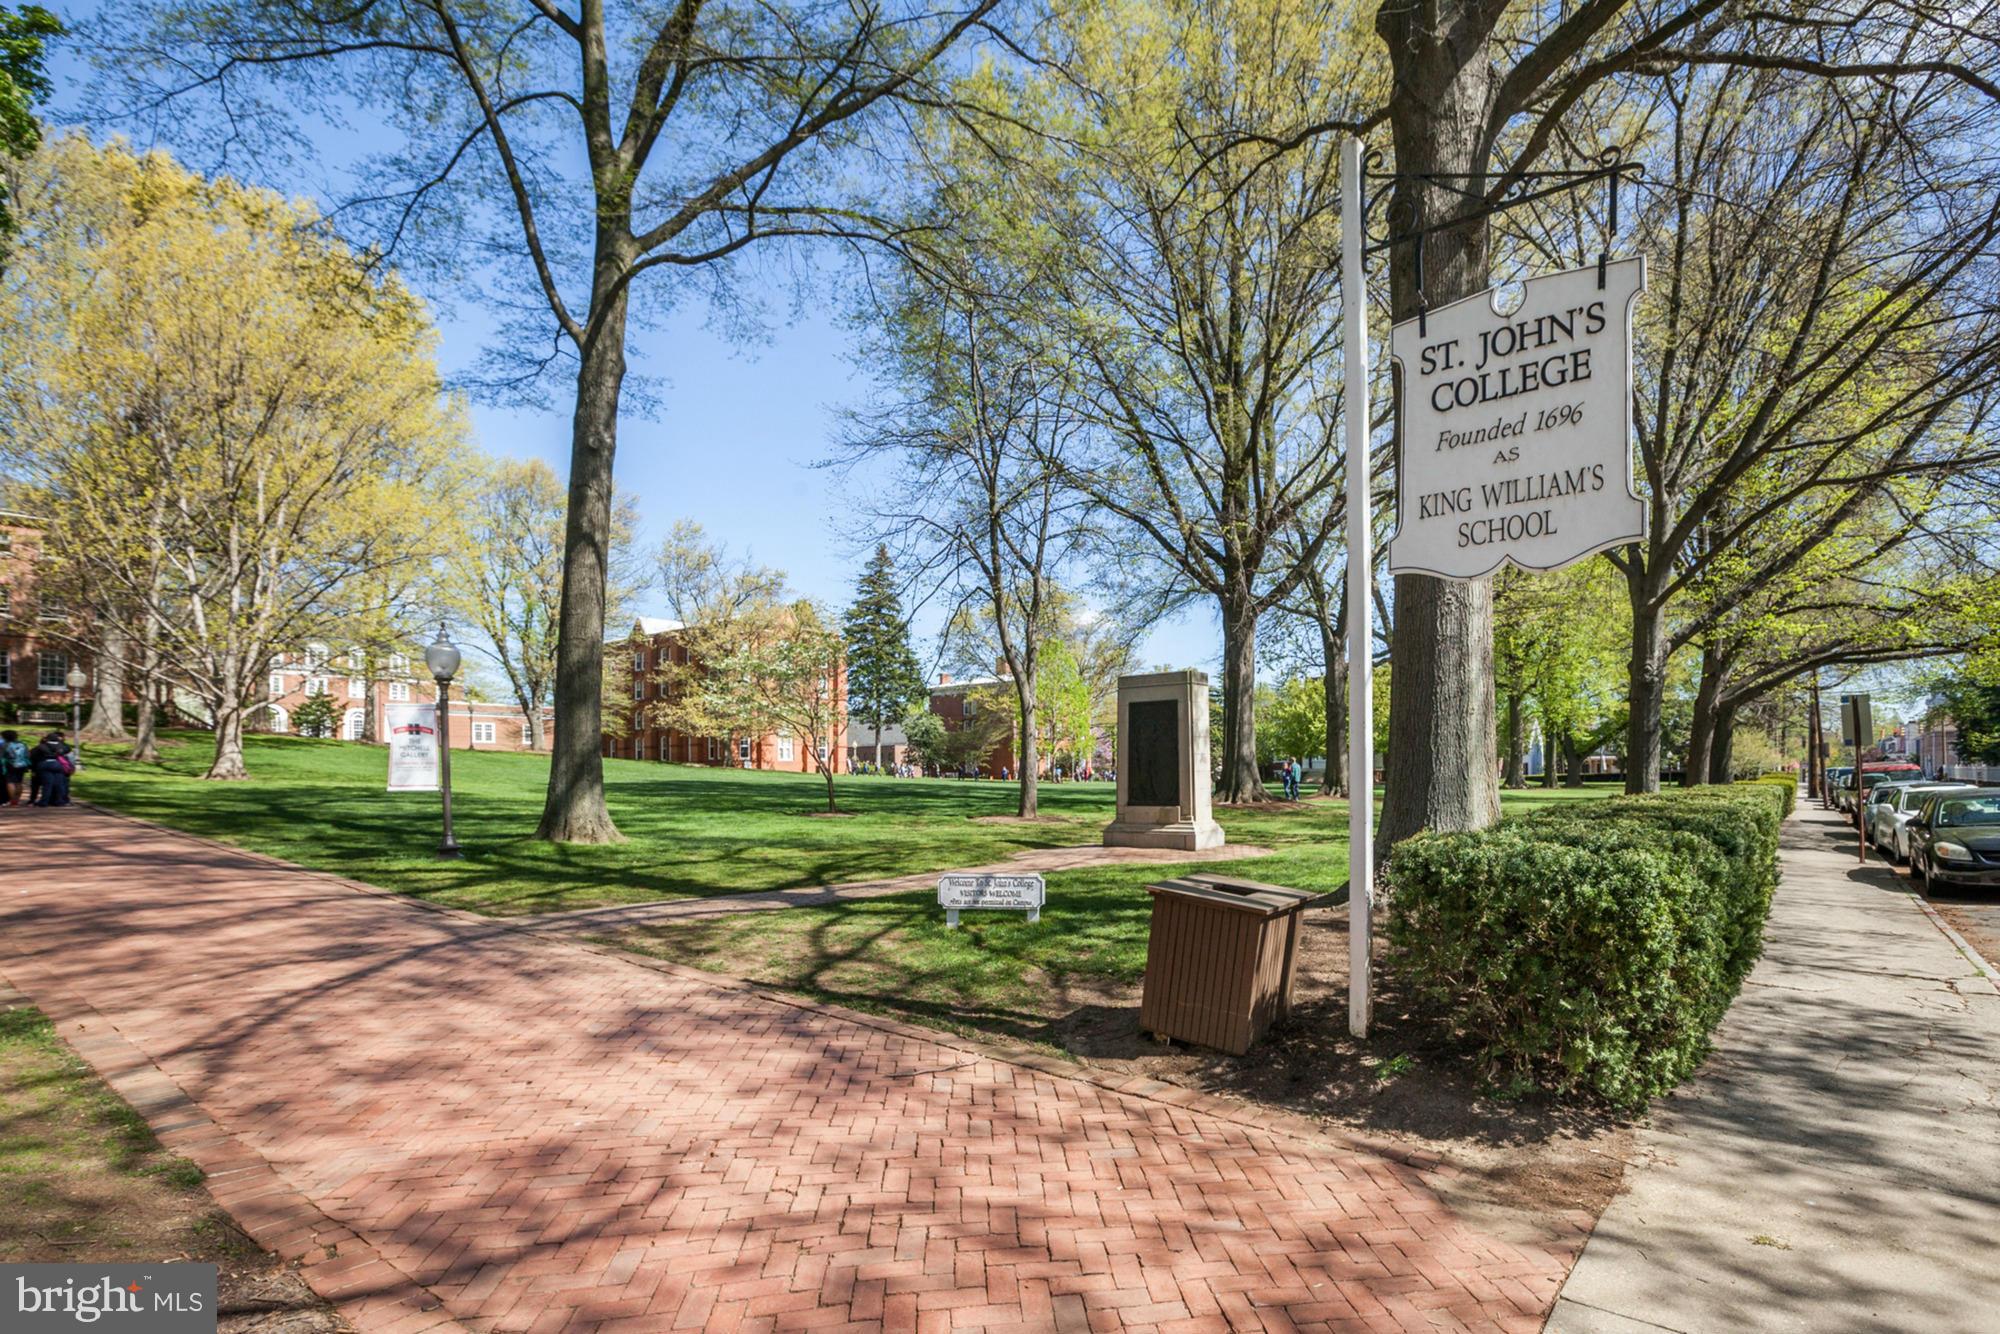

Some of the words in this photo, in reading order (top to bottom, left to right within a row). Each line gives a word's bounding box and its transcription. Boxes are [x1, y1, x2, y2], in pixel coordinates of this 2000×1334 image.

[1420, 339, 1464, 375] ST.
[1475, 301, 1606, 370] JOHN'S
[1431, 348, 1593, 413] COLLEGE
[1435, 412, 1527, 452] Founded
[1533, 402, 1585, 432] 1696
[1492, 447, 1520, 465] AS
[1419, 487, 1472, 520] KING
[1481, 464, 1605, 508] WILLIAM'S
[1458, 510, 1558, 548] SCHOOL
[949, 878, 974, 887] Welcome
[1013, 878, 1034, 889] College
[960, 890, 988, 898] VISITORS
[989, 890, 1022, 898] WELCOME
